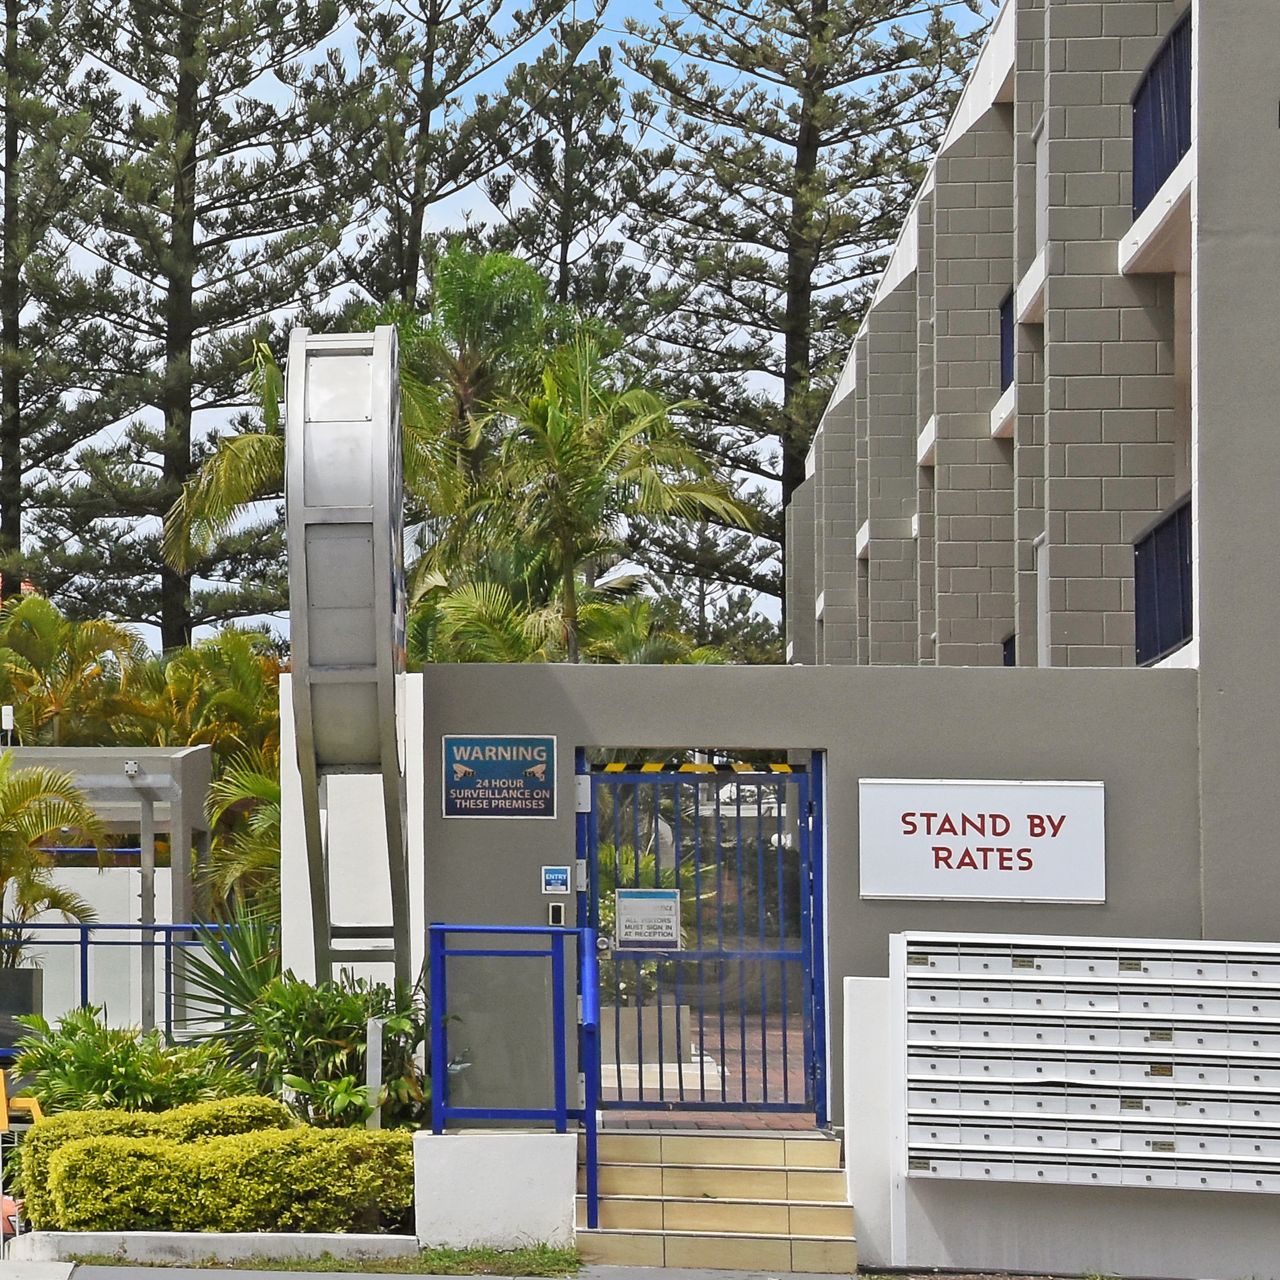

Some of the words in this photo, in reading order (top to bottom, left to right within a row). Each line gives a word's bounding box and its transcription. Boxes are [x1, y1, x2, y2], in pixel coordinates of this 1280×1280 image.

[452, 746, 547, 761] WARNING
[476, 779, 489, 788] 24
[491, 779, 524, 788] HOUR
[450, 789, 531, 798] SURVEILLANCE
[533, 789, 550, 798] ON
[455, 800, 489, 809] THESE
[491, 800, 545, 809] PREMISES
[901, 812, 1011, 838] STAND
[1027, 814, 1067, 838] BY
[931, 846, 1033, 871] RATES
